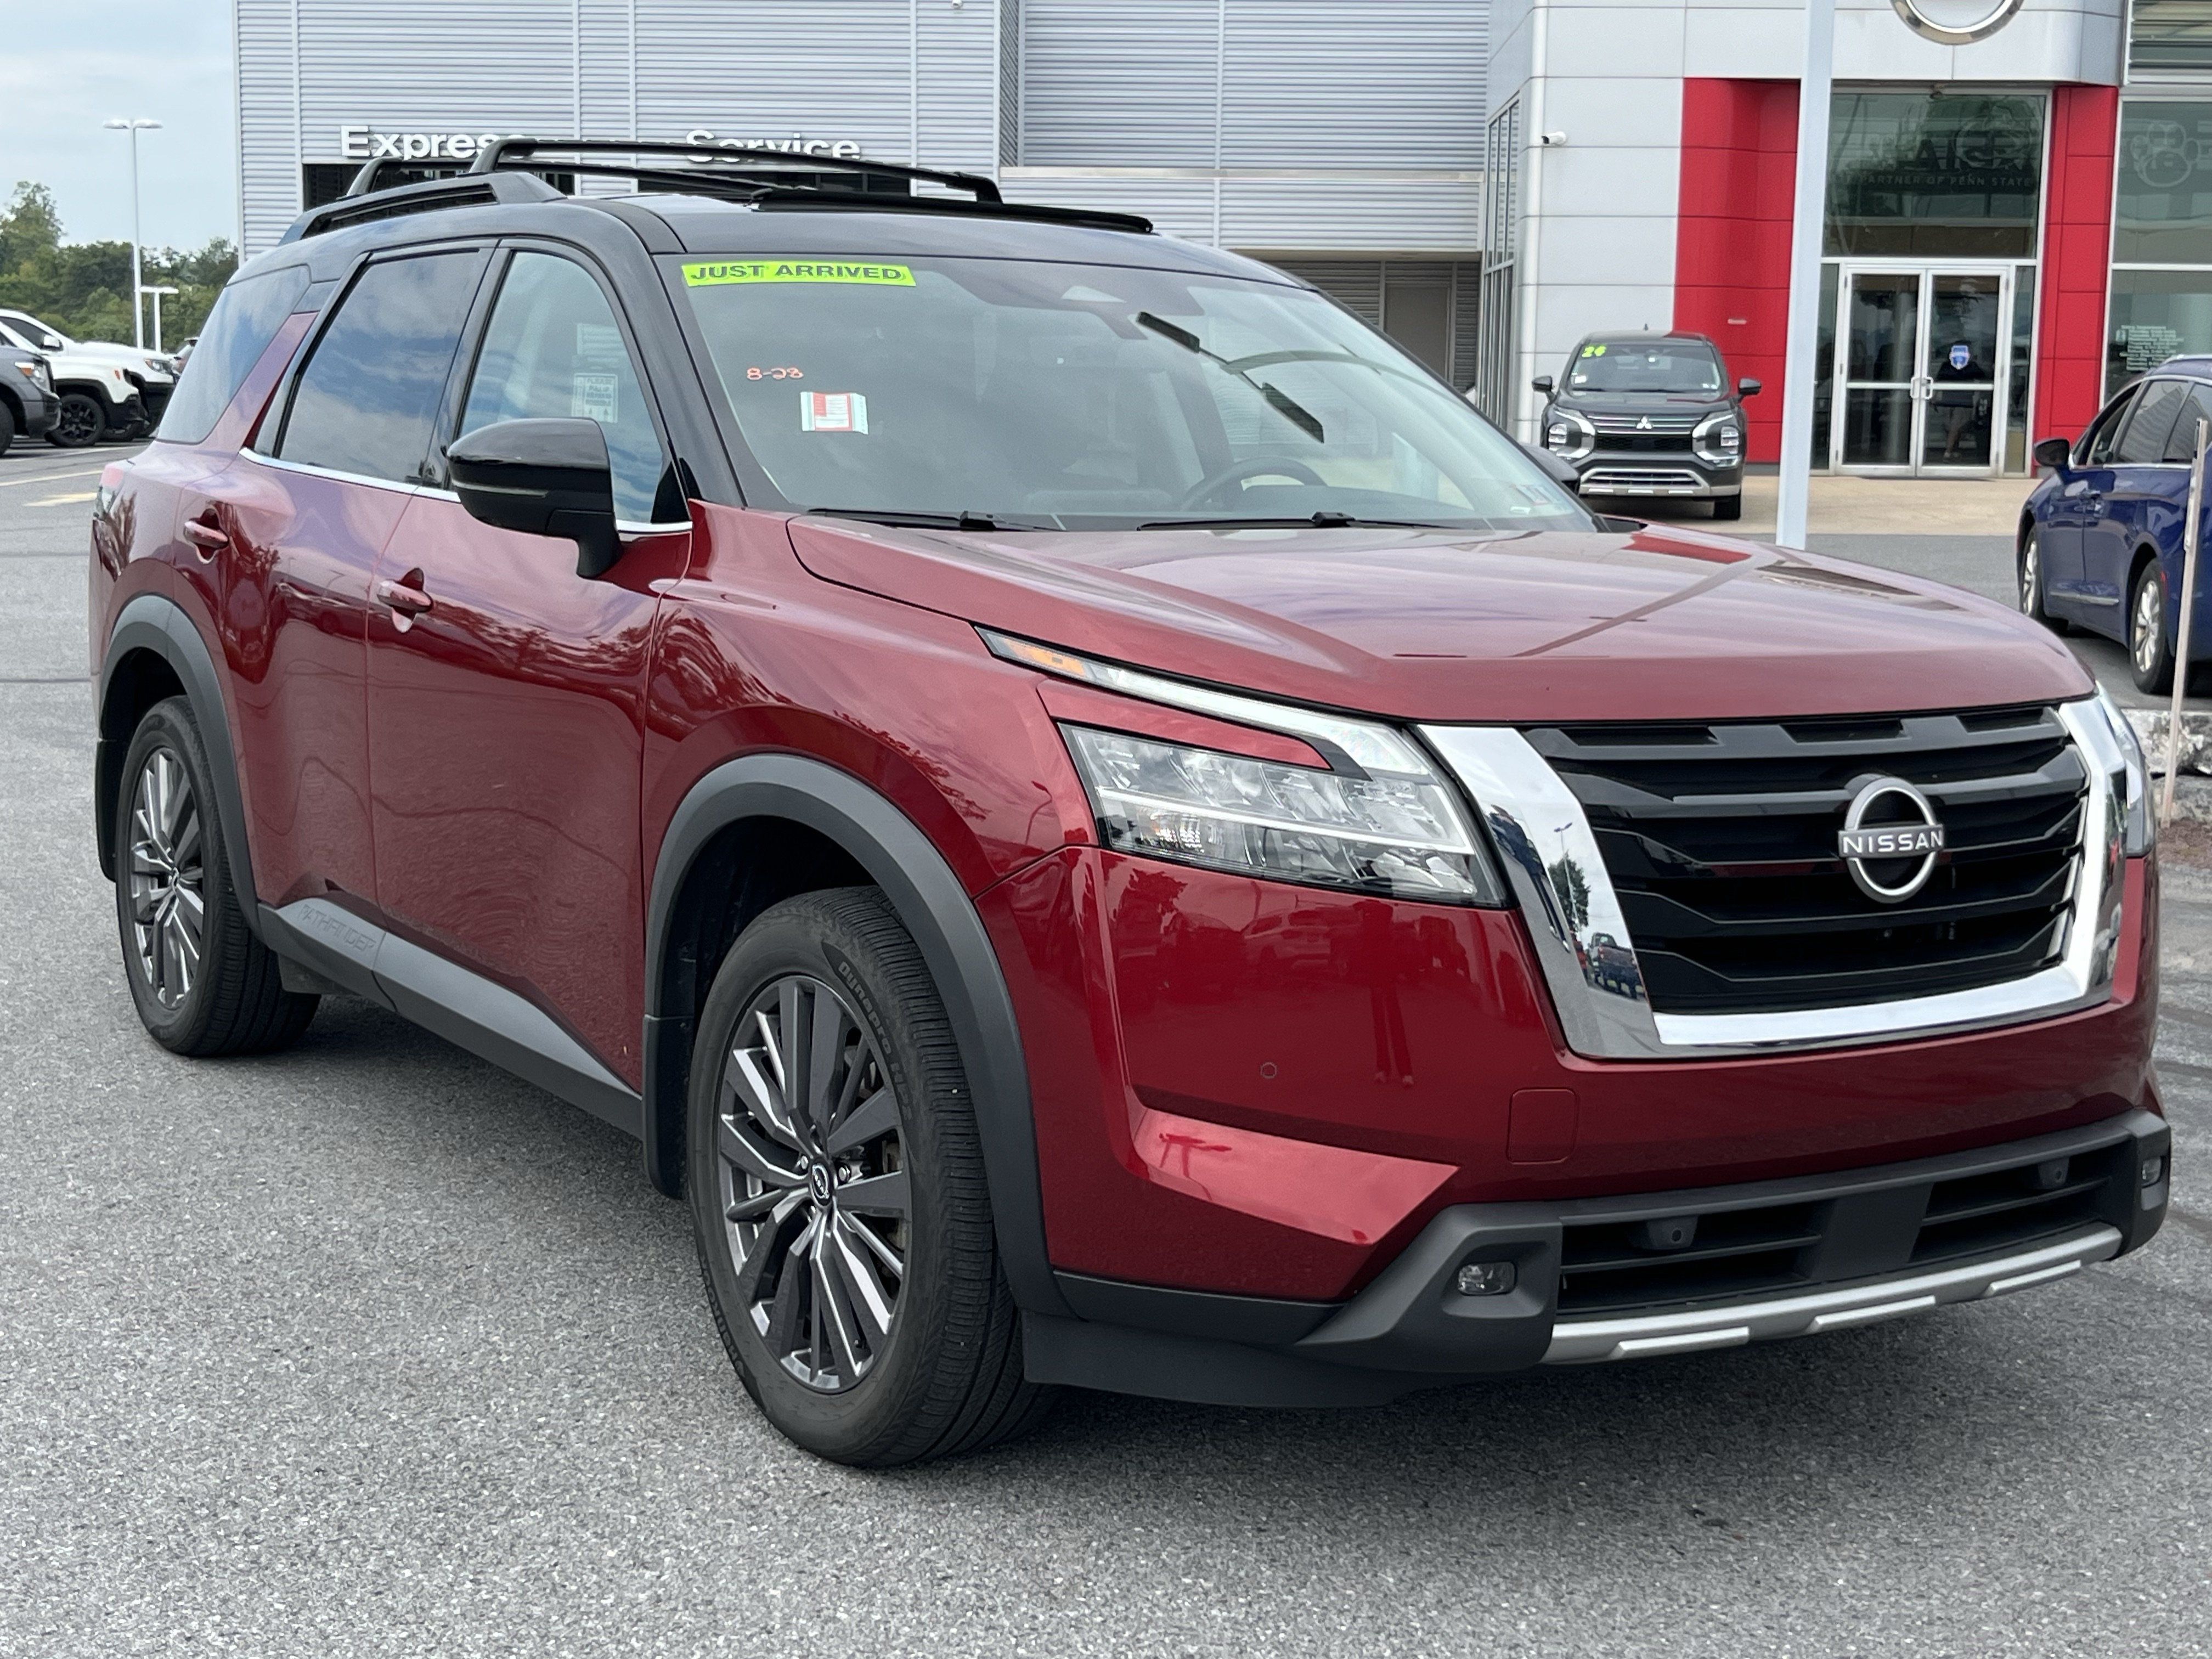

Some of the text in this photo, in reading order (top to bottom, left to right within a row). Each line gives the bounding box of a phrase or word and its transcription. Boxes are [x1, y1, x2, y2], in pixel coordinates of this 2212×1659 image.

[691, 264, 902, 280] JUST ARRIVED
[1842, 830, 1943, 854] NISSAN
[297, 904, 376, 951] PATHFINDER
